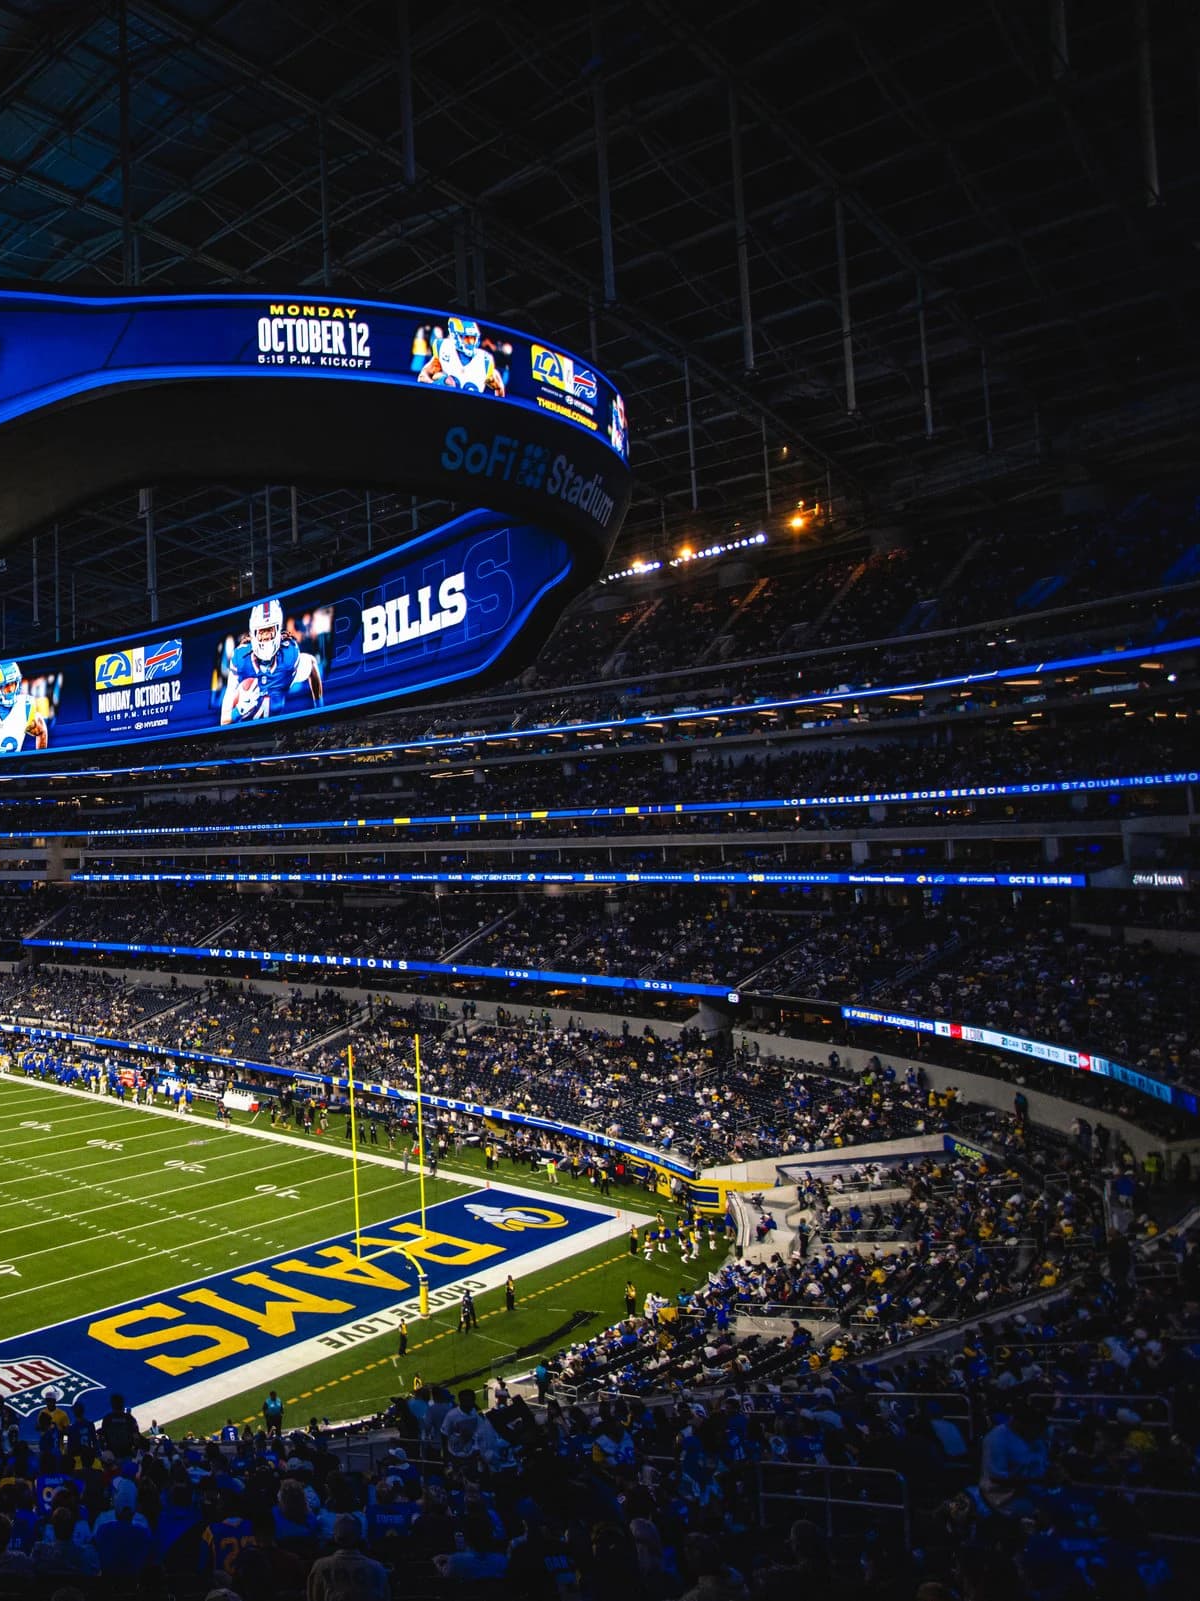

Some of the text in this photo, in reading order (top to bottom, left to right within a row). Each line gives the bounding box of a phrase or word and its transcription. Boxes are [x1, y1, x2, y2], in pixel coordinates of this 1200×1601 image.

[269, 304, 357, 319] MONDAY
[258, 317, 371, 357] OCTOBER 12
[257, 354, 372, 369] 5:15 P.M. KICKOFF
[440, 426, 615, 528] SoFi Stadium
[361, 571, 467, 654] BILLS
[98, 680, 181, 713] MONDAY, OCTOBER 12
[124, 711, 140, 719] P.M.
[142, 705, 173, 716] KICKOFF
[783, 798, 807, 806] LOS
[811, 794, 870, 804] ANGELES
[875, 792, 908, 801] RAMS
[951, 786, 1006, 798] SEASON
[1022, 783, 1055, 793] SOFI
[1008, 876, 1026, 884] OCT
[209, 949, 408, 971] WORLD CHAMPIONS
[505, 970, 529, 978] 1999
[644, 981, 672, 990] 2021
[851, 1009, 884, 1022] FANTASY
[883, 1015, 916, 1028] LEADERS
[254, 1184, 301, 1200] 10
[87, 1223, 507, 1377] RAMS
[316, 1316, 395, 1349] LOVE
